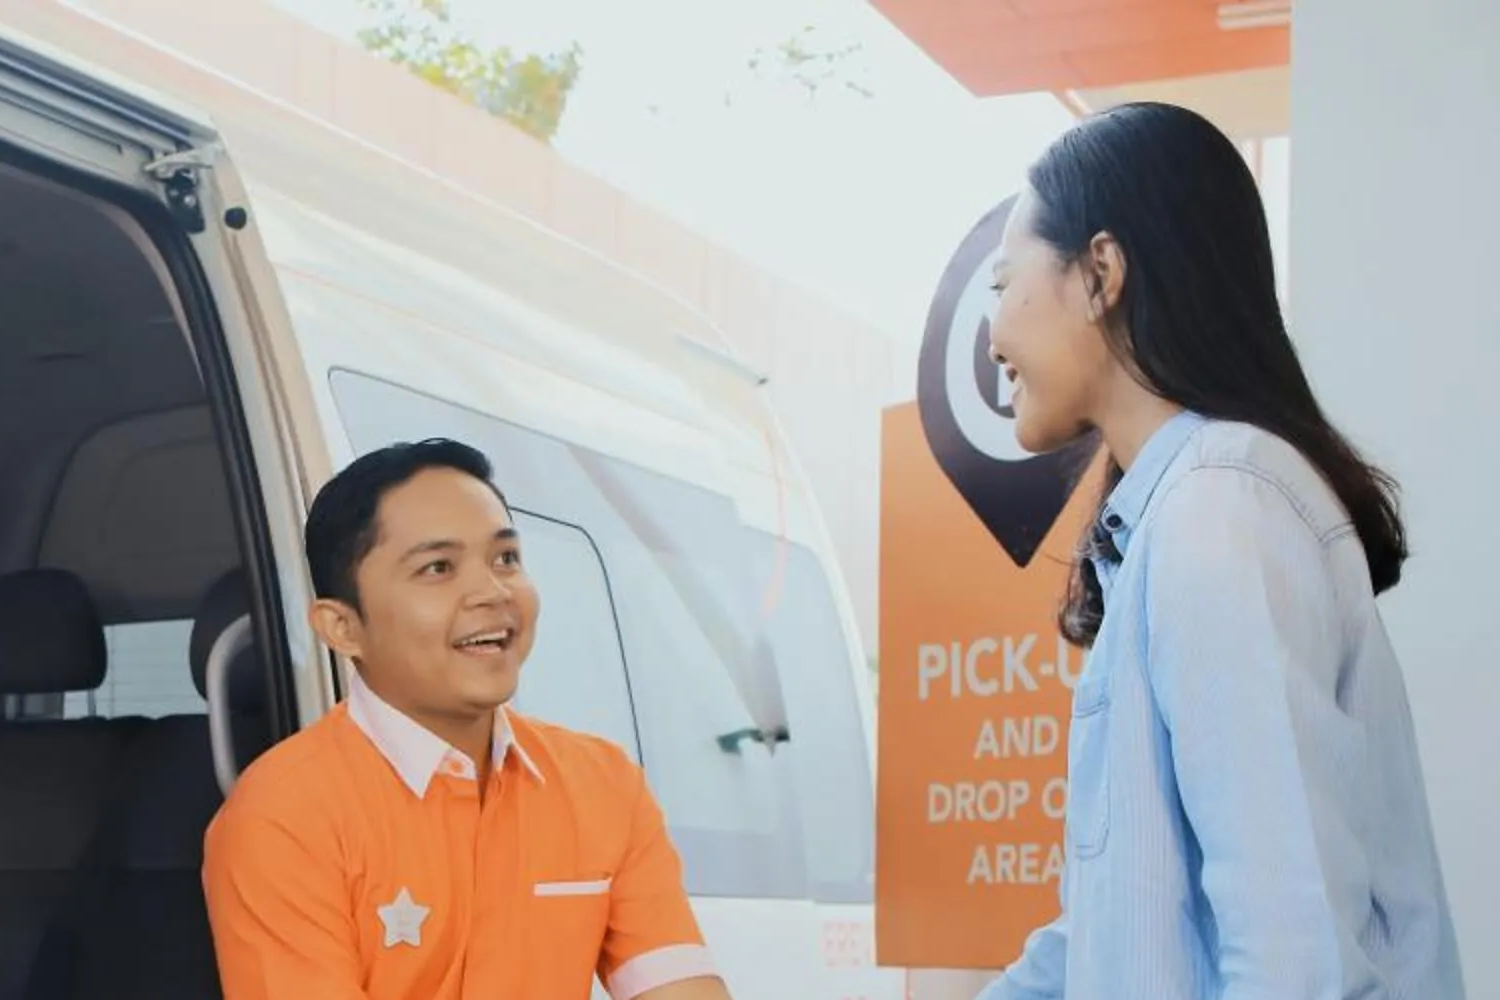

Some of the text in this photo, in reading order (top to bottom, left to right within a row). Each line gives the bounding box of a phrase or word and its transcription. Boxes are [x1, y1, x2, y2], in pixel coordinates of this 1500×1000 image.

[973, 715, 1059, 760] AND
[927, 781, 1030, 823] DROP
[966, 842, 1066, 884] AREA
